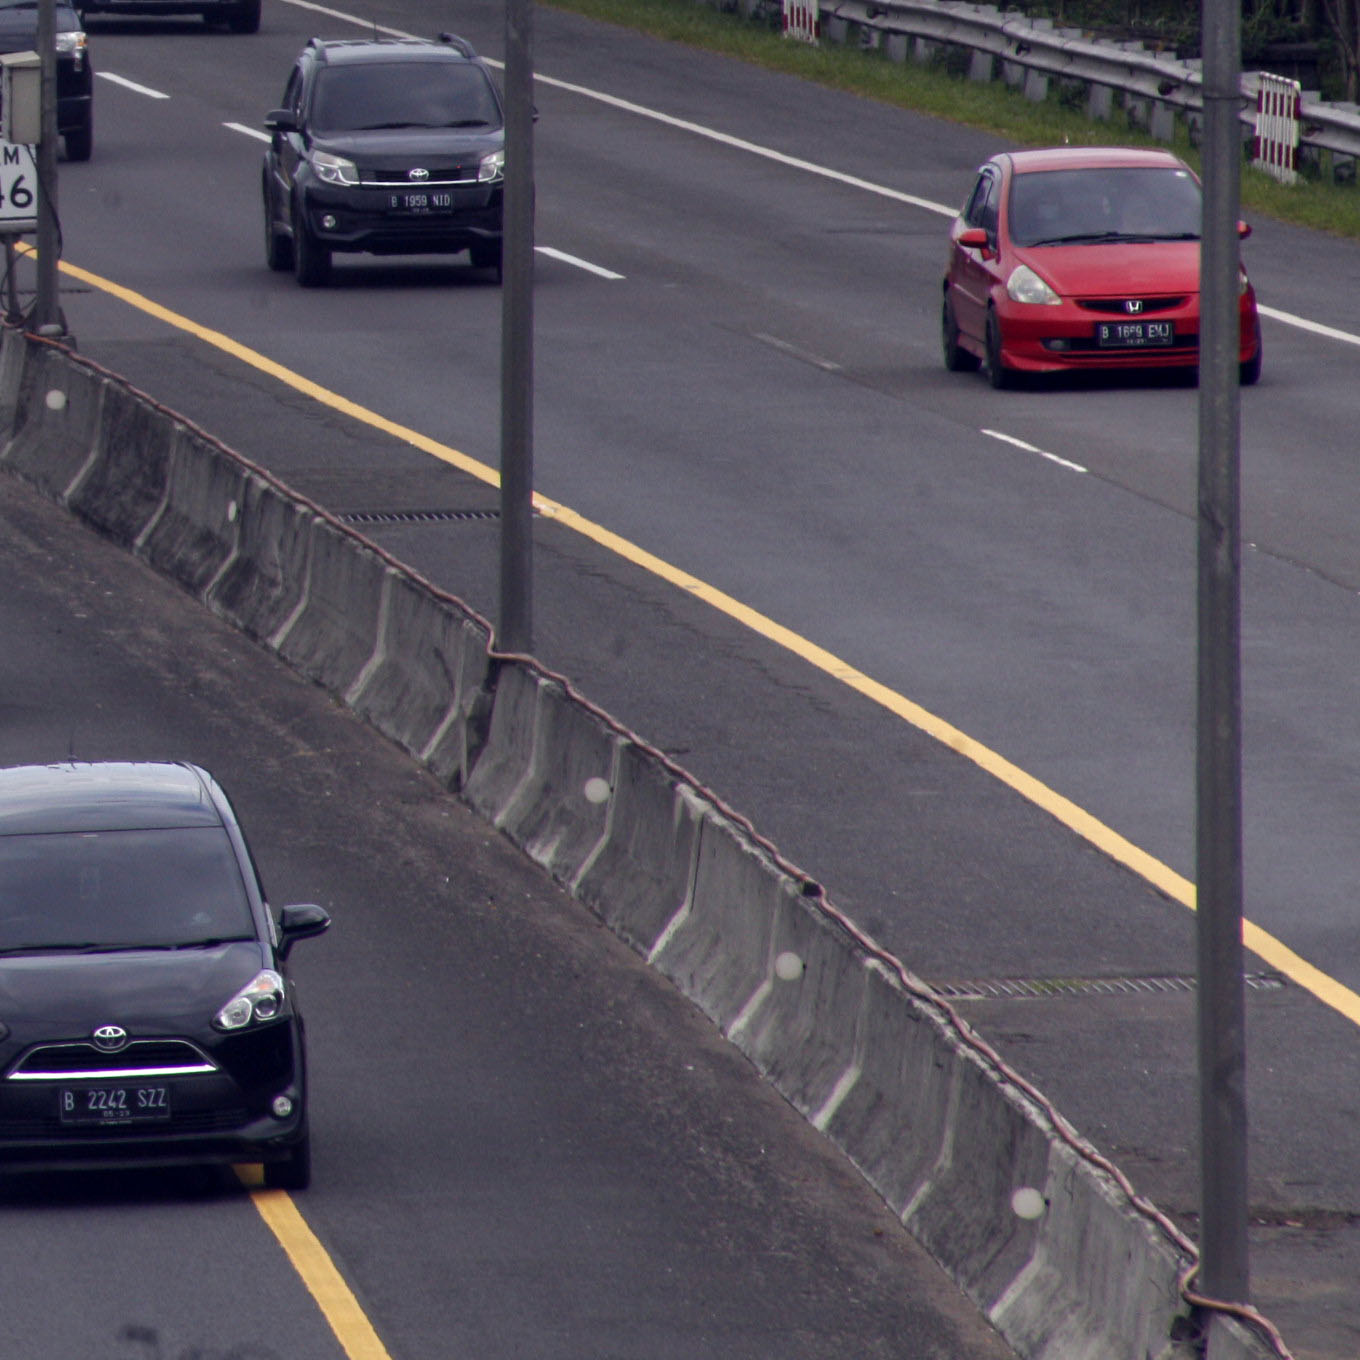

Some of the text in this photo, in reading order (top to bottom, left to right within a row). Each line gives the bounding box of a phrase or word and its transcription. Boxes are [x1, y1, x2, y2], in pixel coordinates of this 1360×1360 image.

[1102, 326, 1109, 339] B
[64, 1087, 167, 1111] B 2242 SZZ
